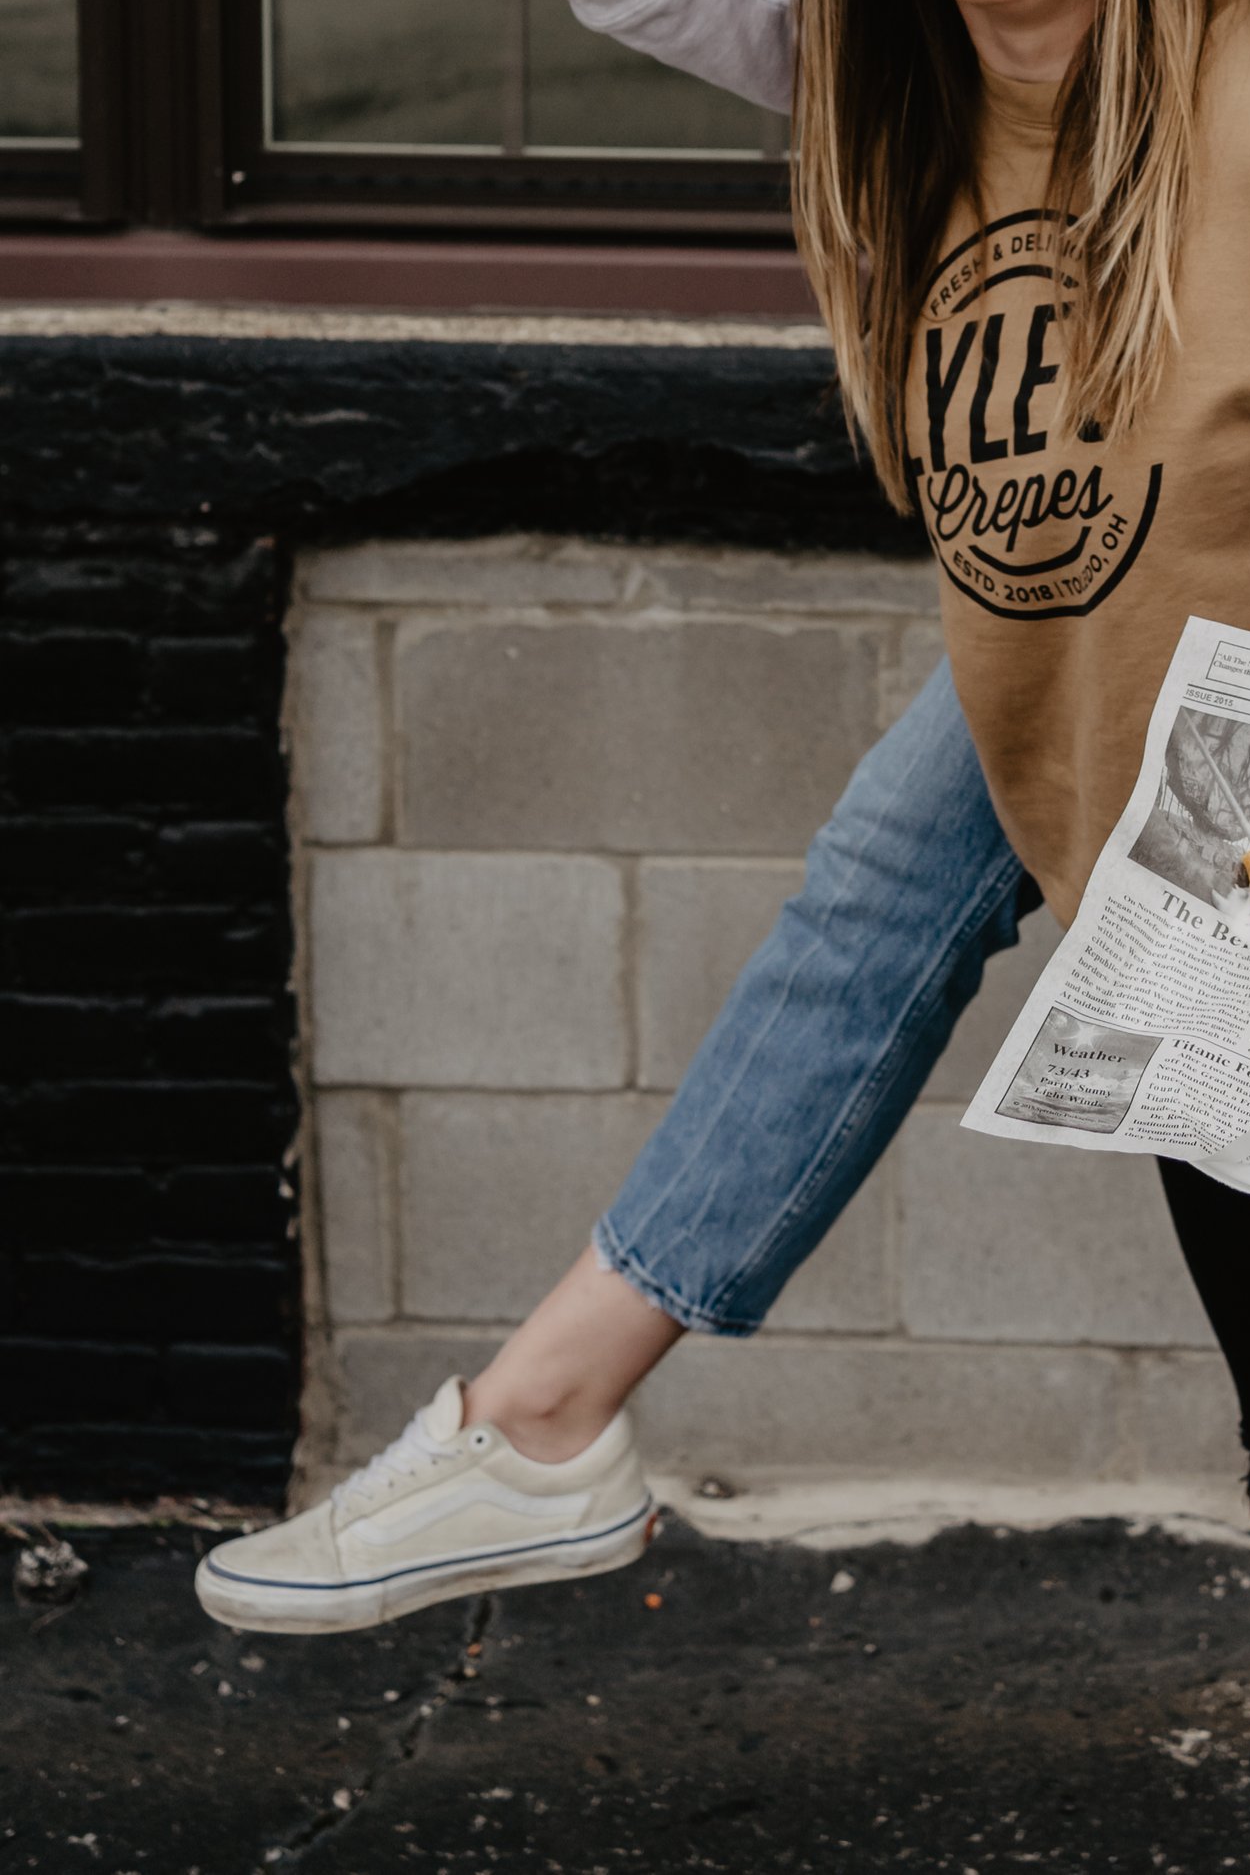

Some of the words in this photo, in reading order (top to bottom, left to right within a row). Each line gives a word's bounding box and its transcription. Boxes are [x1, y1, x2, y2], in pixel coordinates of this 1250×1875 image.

[930, 258, 981, 317] FRESH
[993, 243, 1003, 261] &
[927, 463, 1114, 553] Crepes
[954, 551, 999, 596] ESTD.
[1004, 584, 1054, 603] 2018
[1102, 513, 1128, 550] OH
[1213, 660, 1242, 674] Changes
[1234, 656, 1247, 665] The
[1185, 688, 1213, 702] ISSUE
[1213, 696, 1234, 707] 2015
[1123, 895, 1136, 906] On
[1138, 902, 1176, 930] November
[1162, 890, 1203, 929] The
[1085, 945, 1119, 974] Republic
[1054, 1043, 1126, 1063] Weather
[1172, 1038, 1230, 1067] Titanic
[1047, 1064, 1090, 1078] 73/43
[1035, 1087, 1064, 1099] Light
[1069, 1095, 1103, 1107] Winds
[1041, 1077, 1072, 1091] Partly
[1078, 1085, 1111, 1098] Sunny
